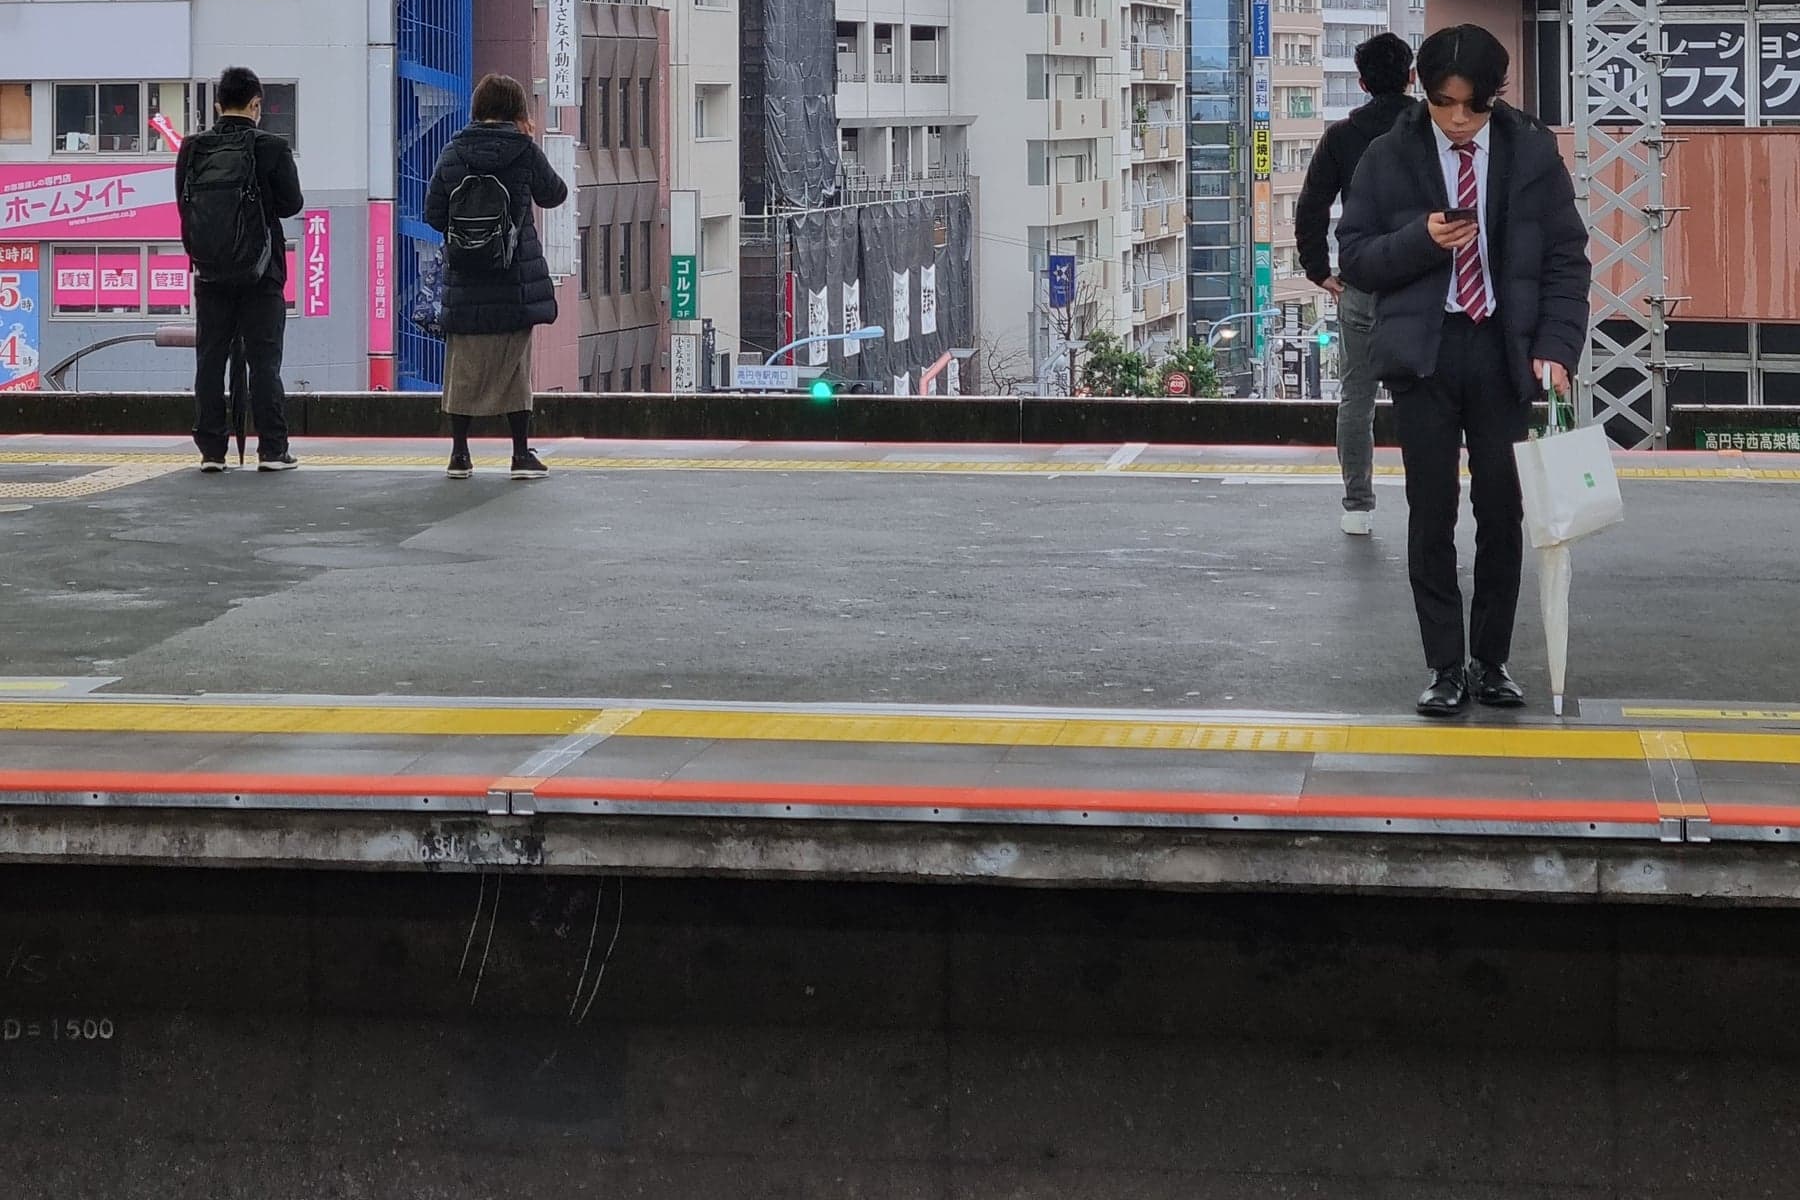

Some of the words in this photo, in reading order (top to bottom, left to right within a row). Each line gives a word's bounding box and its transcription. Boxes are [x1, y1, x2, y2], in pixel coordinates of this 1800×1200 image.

[1256, 79, 1268, 107] 歯科
[1256, 131, 1268, 168] 日焼け
[5, 179, 136, 223] ホームメイト
[0, 246, 33, 263] 時間
[308, 215, 327, 313] ホームメイト
[61, 272, 91, 288] 賃貸
[103, 272, 134, 288] 売買
[154, 272, 184, 288] 管理
[676, 259, 691, 307] ゴルフ
[677, 310, 690, 318] 3F
[1705, 432, 1800, 450] 高円寺西高架橋
